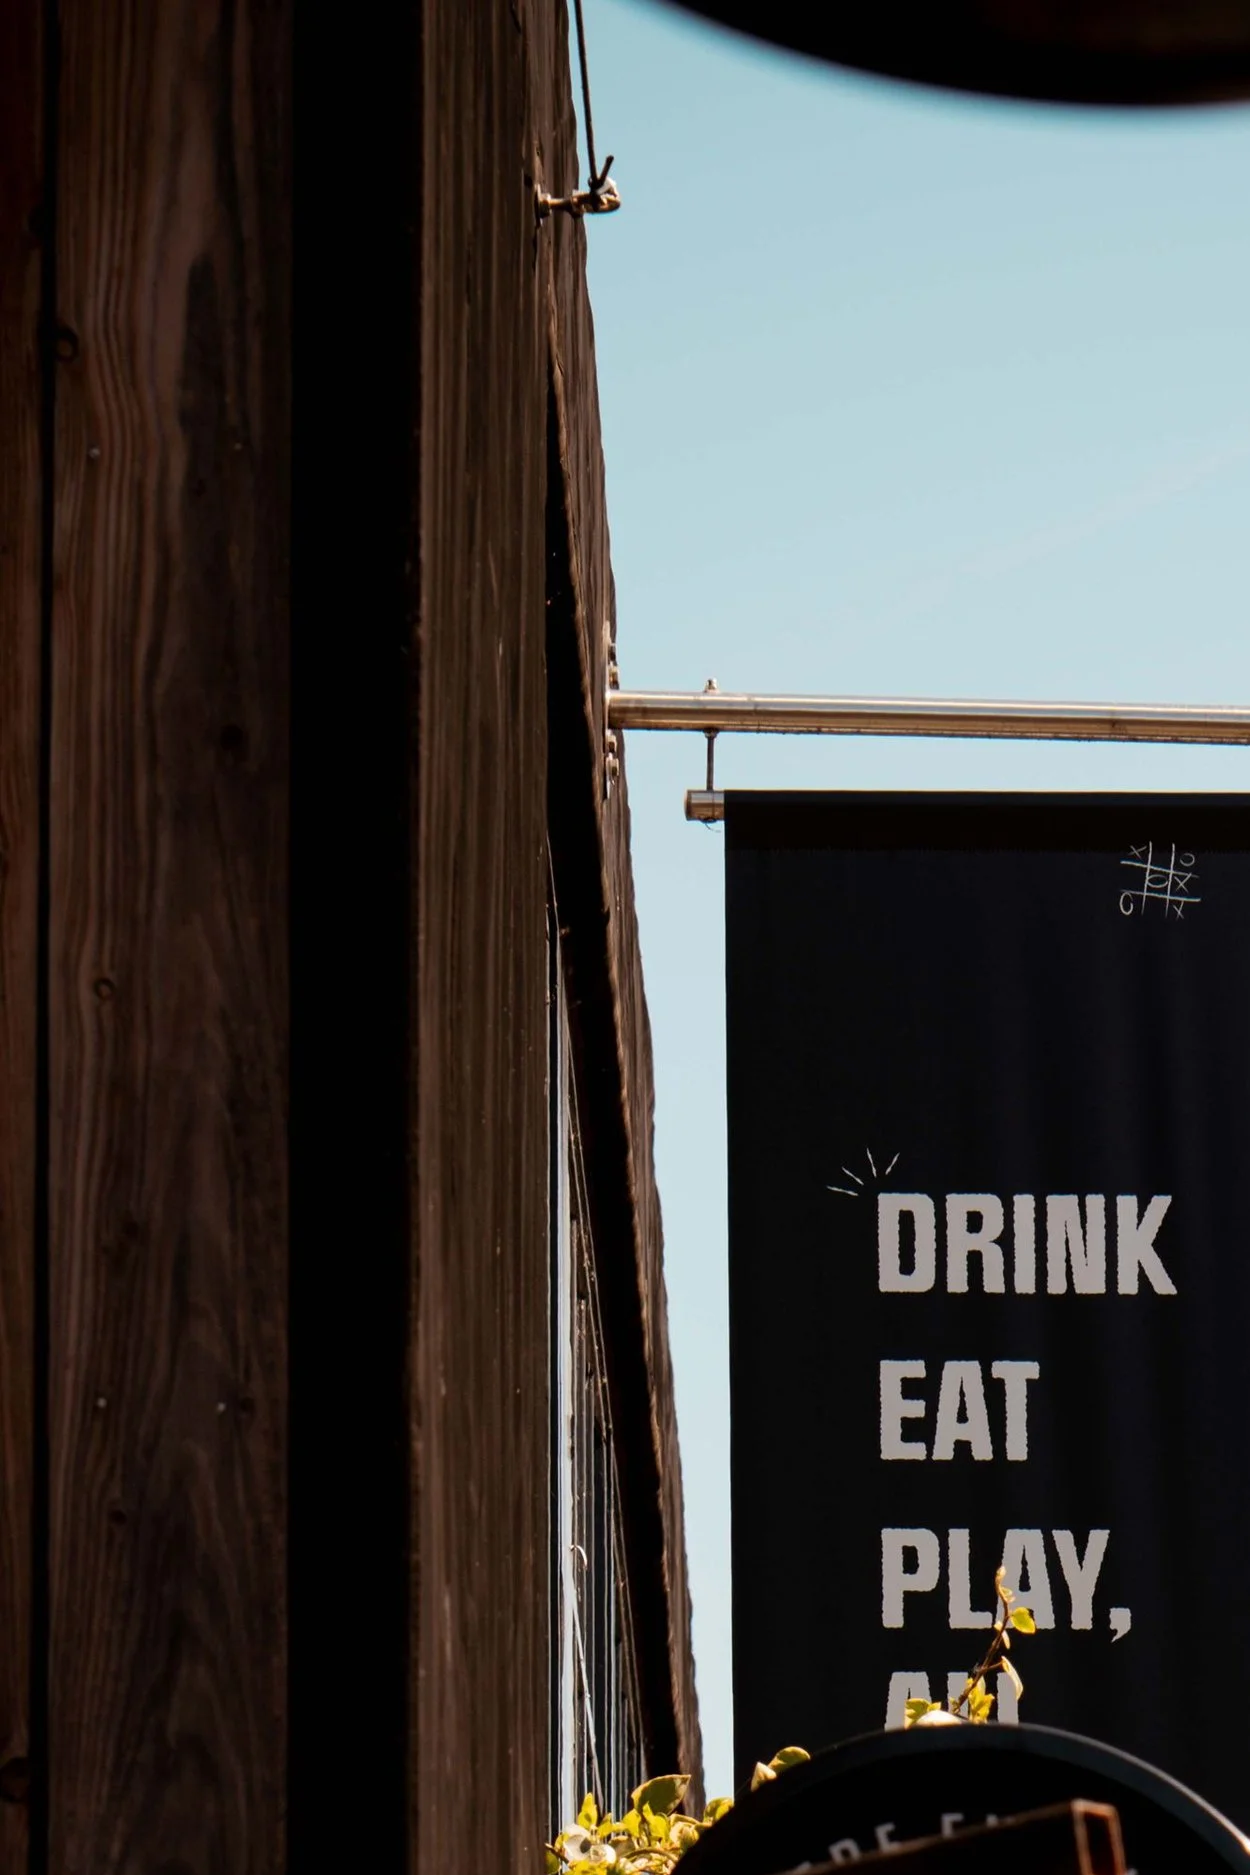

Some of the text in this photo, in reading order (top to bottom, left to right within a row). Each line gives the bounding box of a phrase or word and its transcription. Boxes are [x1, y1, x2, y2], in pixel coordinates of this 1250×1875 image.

[877, 1192, 1177, 1295] DRINK
[880, 1359, 1040, 1461] EAT
[881, 1527, 1132, 1643] PLAY,
